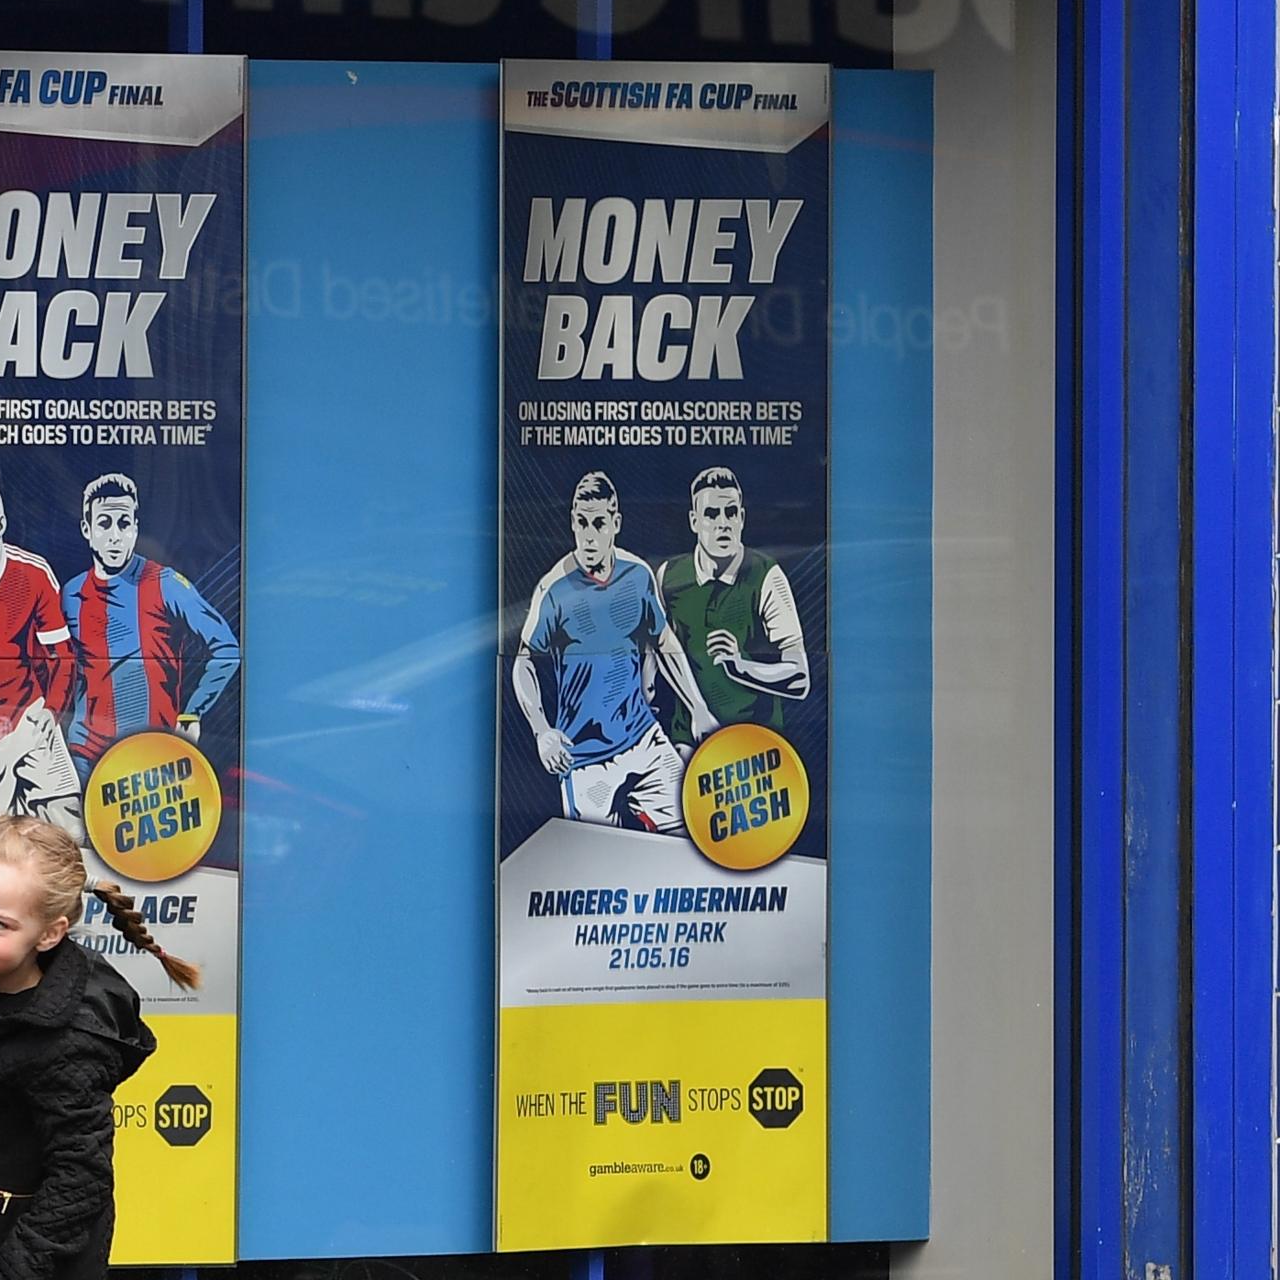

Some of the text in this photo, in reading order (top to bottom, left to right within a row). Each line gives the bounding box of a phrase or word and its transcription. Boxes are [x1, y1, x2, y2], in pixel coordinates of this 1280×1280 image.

[38, 70, 108, 106] CUP
[109, 83, 163, 106] FINAL
[528, 81, 797, 110] THE SCOTTISH FA CUP FINAL
[523, 196, 804, 284] MONEY
[538, 295, 756, 380] BACK
[45, 400, 162, 420] GOALSCORER
[166, 400, 216, 420] BETS
[519, 401, 802, 421] ON LOSING FIRST GOALSCORER BETS
[23, 425, 67, 444] GOES
[70, 425, 93, 444] TO
[96, 425, 157, 445] EXTRA
[521, 427, 533, 445] IF
[535, 426, 561, 445] THE
[564, 426, 615, 446] MATCH
[618, 426, 662, 446] GOES
[665, 426, 687, 446] TO
[690, 426, 746, 446] EXTRA
[101, 757, 192, 807] REFUND
[699, 748, 781, 797] REFUND
[120, 784, 184, 820] PAID IN
[714, 775, 773, 809] PAID IN
[114, 798, 202, 853] CASH
[710, 788, 791, 843] CASH
[528, 886, 788, 917] RANGERS v HIBERNIAN
[575, 922, 727, 946] HAMPDEN PARK
[609, 948, 690, 969] 21.05.16
[158, 1103, 208, 1128] STOP
[516, 1080, 800, 1126] WHEN THE FUN STOPS STOP
[590, 1162, 684, 1177] gambleaware.co.uk
